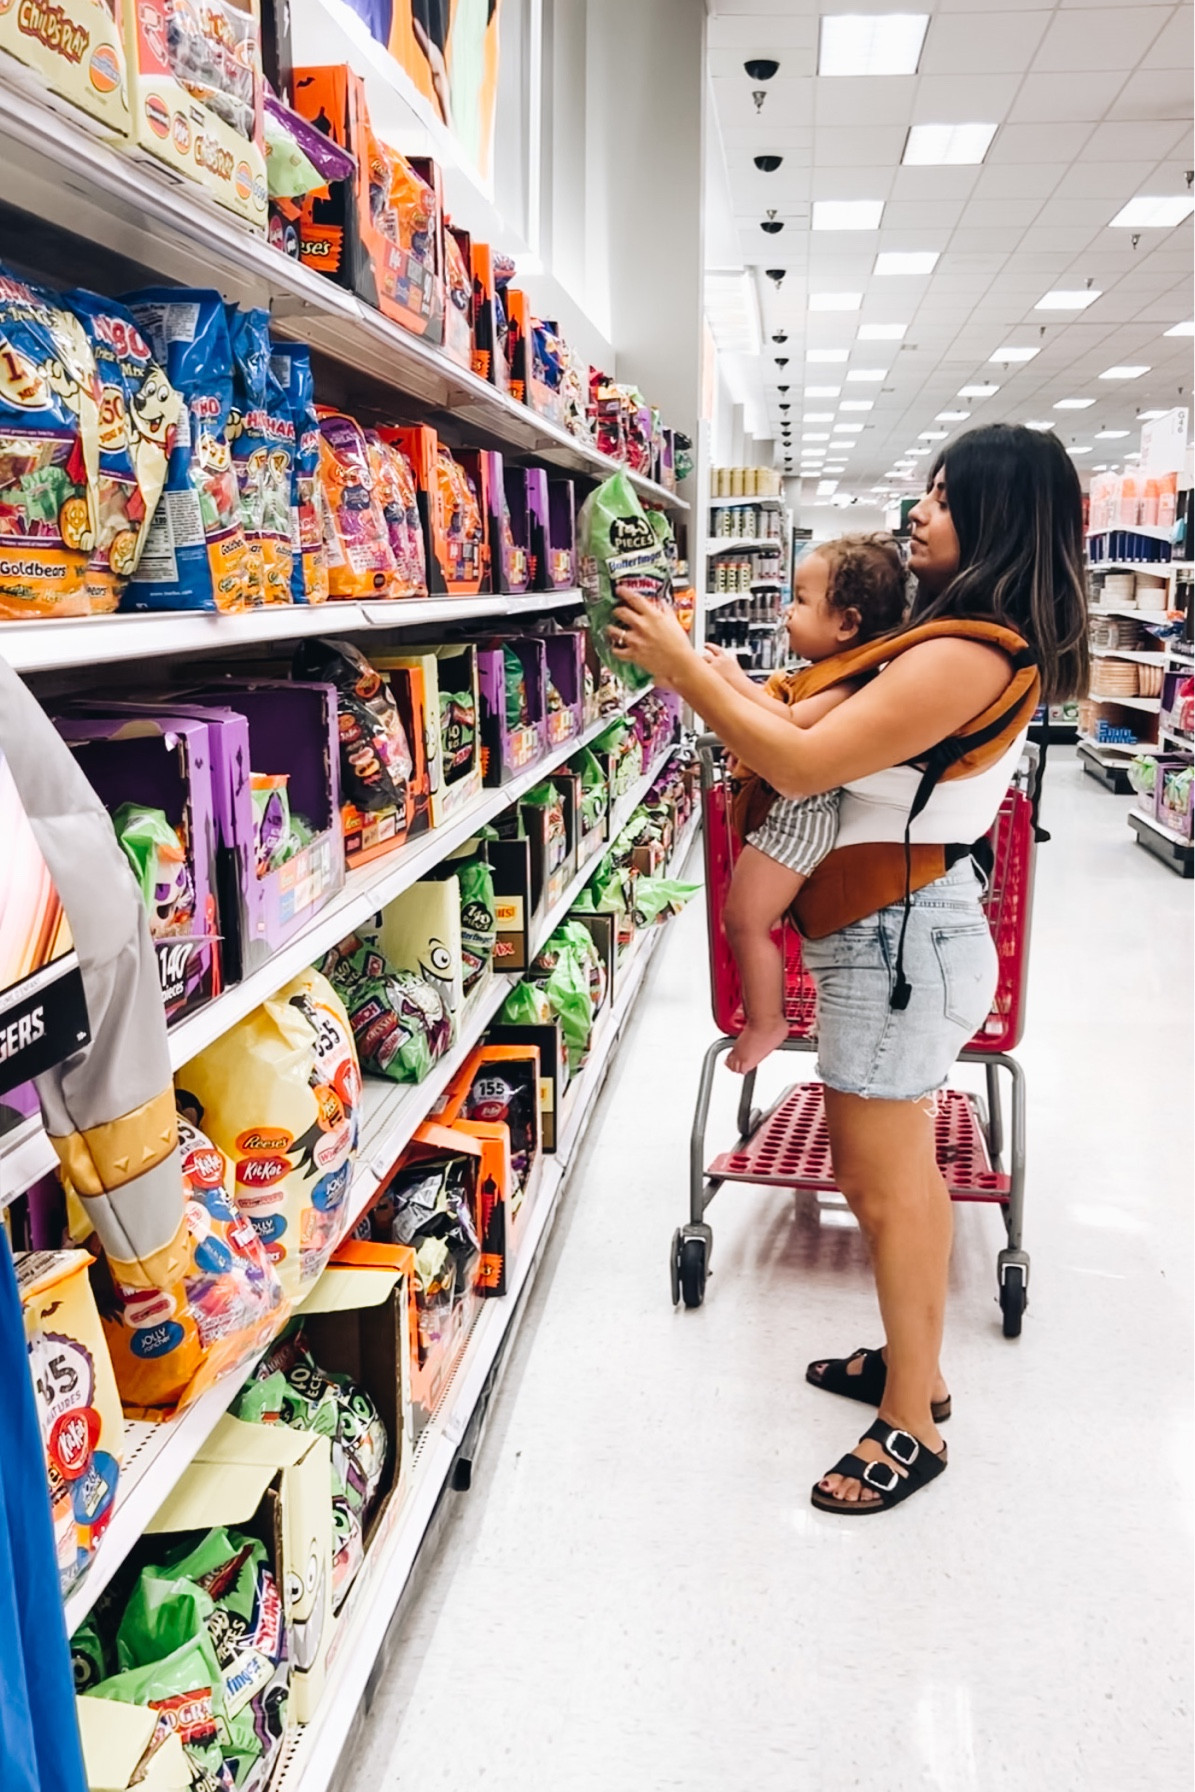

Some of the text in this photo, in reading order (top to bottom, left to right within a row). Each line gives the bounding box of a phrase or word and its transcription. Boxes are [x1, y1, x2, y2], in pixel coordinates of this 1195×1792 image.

[615, 535, 655, 548] PIECES
[0, 560, 67, 578] Goldbears
[160, 943, 193, 987] 140
[479, 1081, 504, 1096] 155
[243, 1134, 290, 1149] Reese's
[141, 1327, 166, 1349] JOLLY
